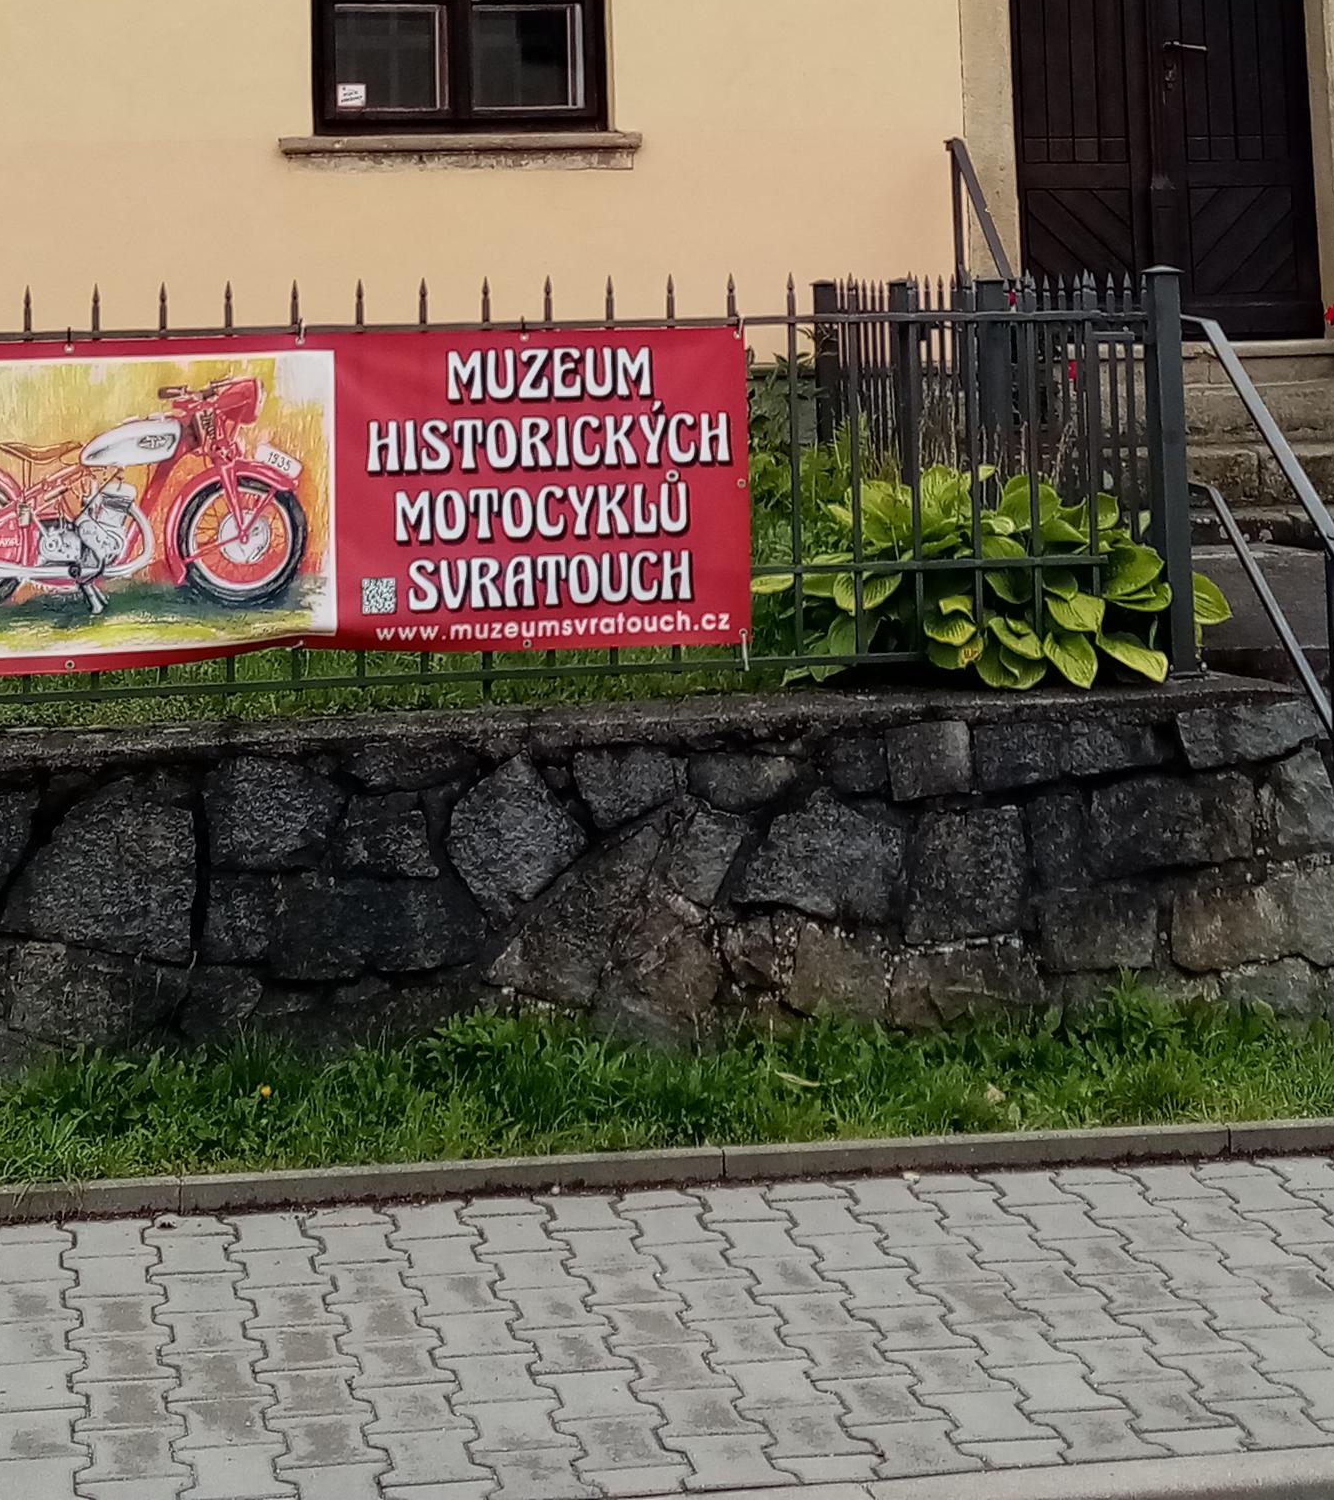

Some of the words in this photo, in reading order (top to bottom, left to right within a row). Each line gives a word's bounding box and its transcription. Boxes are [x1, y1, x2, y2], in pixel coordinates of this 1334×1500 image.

[447, 347, 652, 400] MUZEUM
[267, 451, 291, 471] 1935
[367, 401, 730, 472] HISTORICKÝCH
[395, 469, 687, 541] MOTOCYKLŮ
[408, 550, 692, 611] SVRATOUCH
[376, 610, 730, 641] www.muzeumsvratouch.cz
